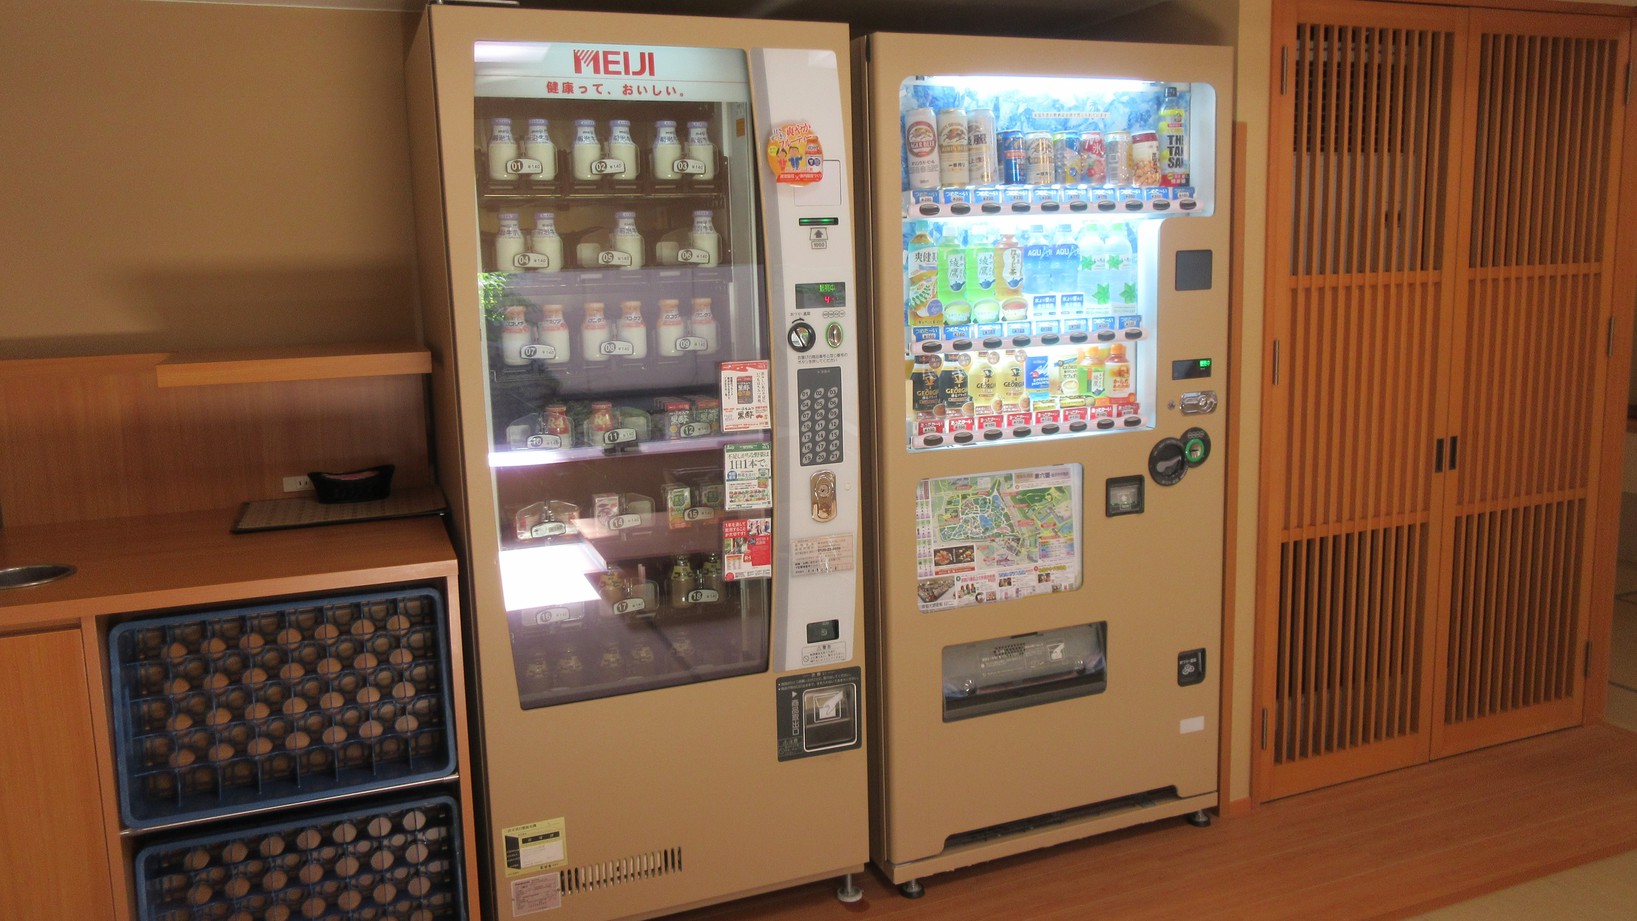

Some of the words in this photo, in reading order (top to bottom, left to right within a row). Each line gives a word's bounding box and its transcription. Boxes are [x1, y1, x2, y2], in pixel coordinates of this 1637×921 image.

[573, 49, 655, 76] MEIJI
[546, 81, 684, 97] 健康って、おいしい。
[511, 161, 521, 171] 01
[596, 162, 606, 170] 02
[678, 162, 687, 170] 03
[520, 256, 529, 264] 04
[603, 254, 612, 262] 05
[525, 347, 535, 356] 07
[684, 425, 694, 435] 12
[608, 432, 618, 440] 11
[688, 510, 698, 518] 15
[614, 519, 623, 527] 14
[692, 592, 701, 600] 18
[617, 603, 626, 611] 17
